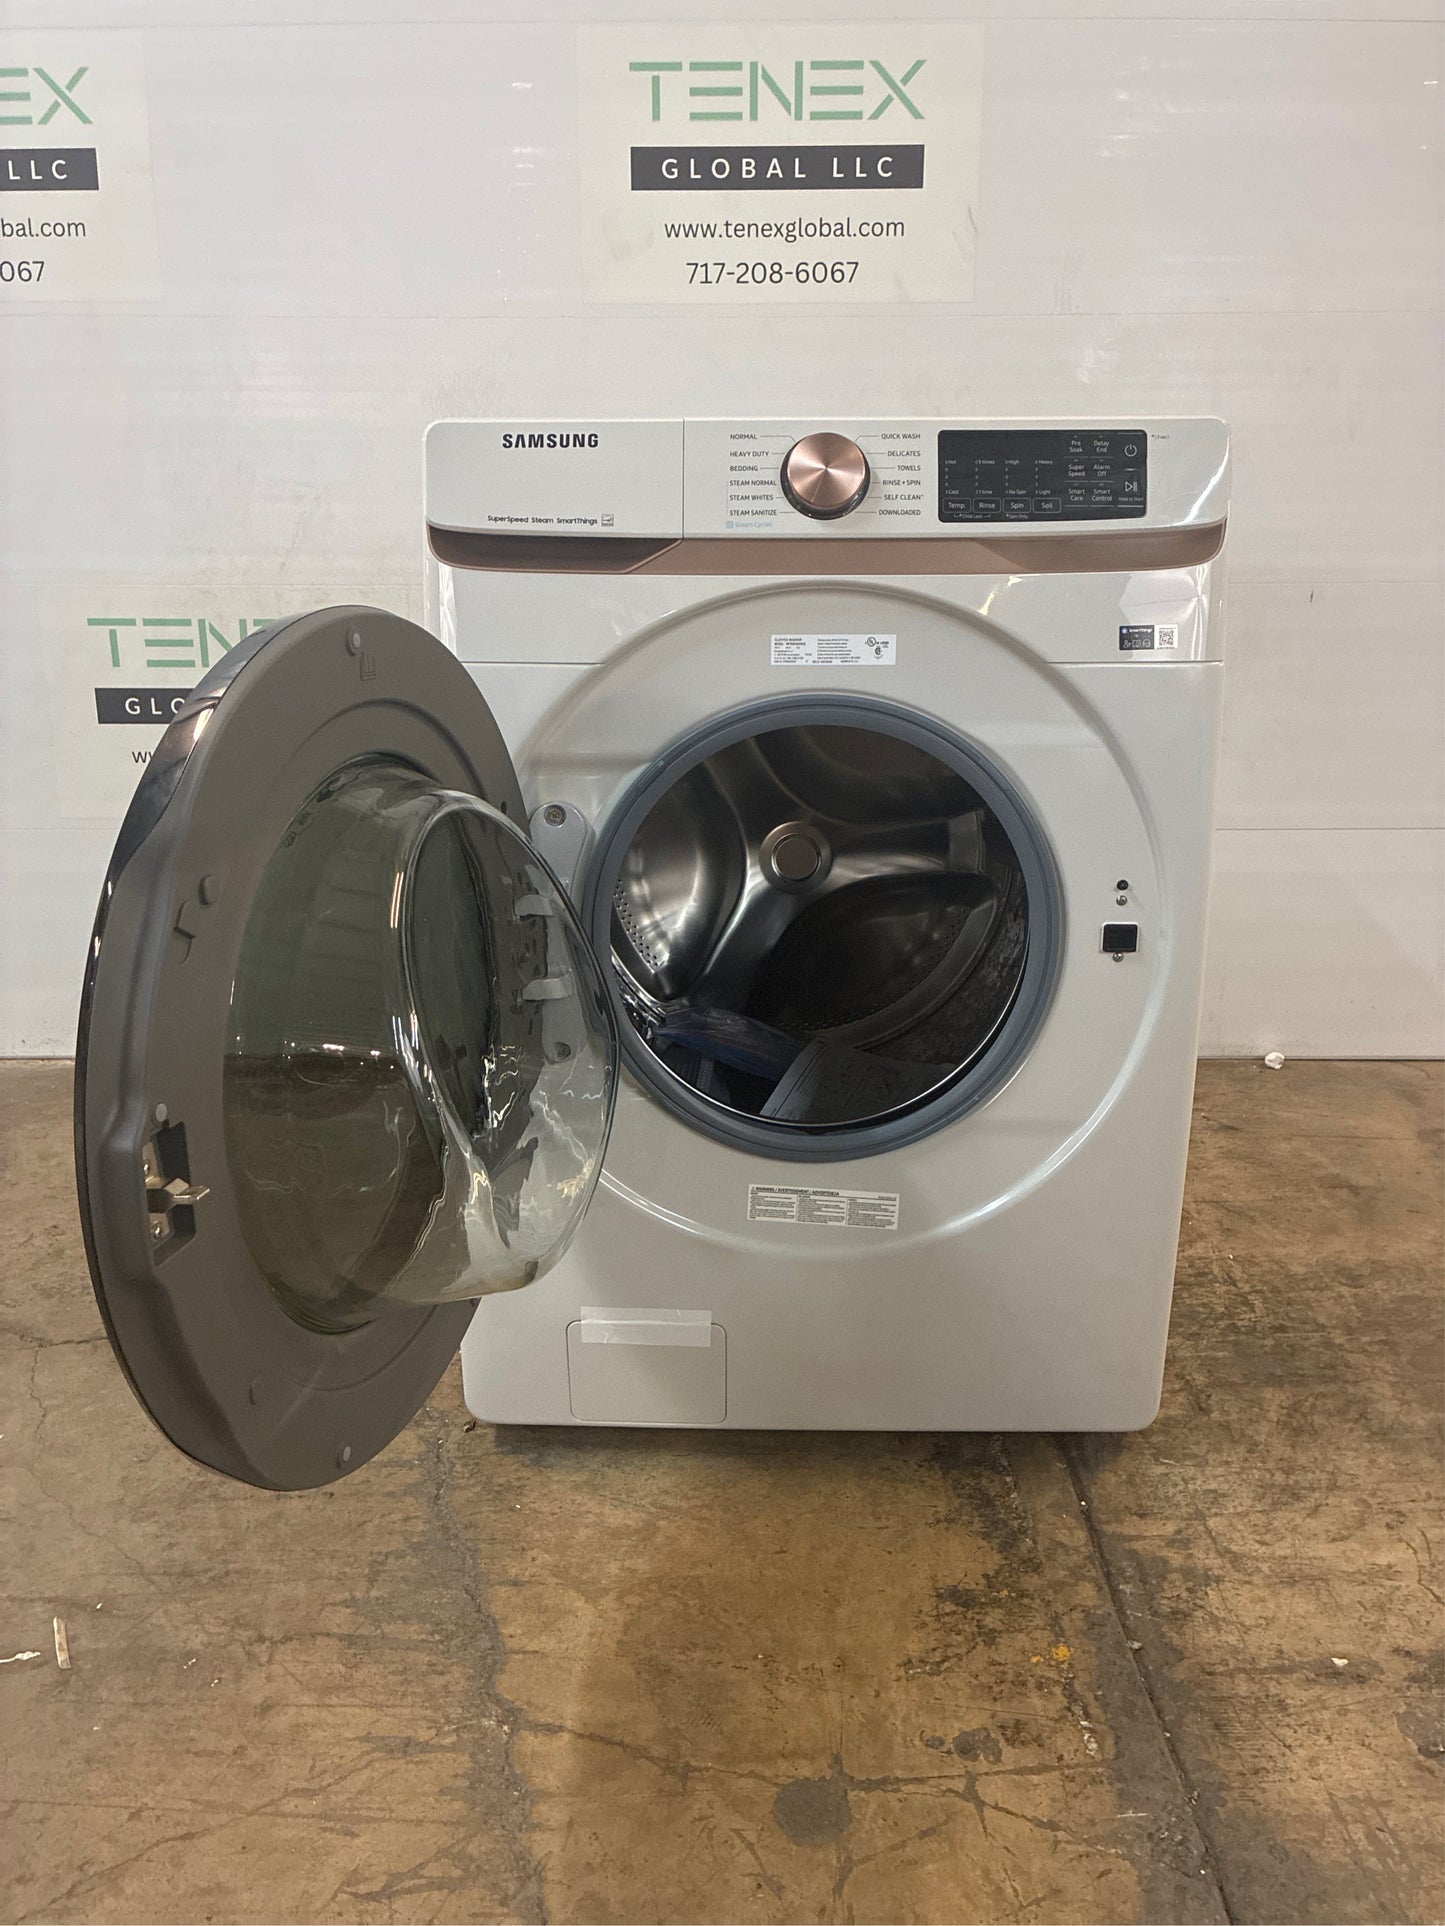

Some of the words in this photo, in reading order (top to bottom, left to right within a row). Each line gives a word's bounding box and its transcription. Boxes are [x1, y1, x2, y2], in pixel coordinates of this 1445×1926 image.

[629, 59, 927, 122] TENEX
[8, 160, 68, 180] LLC
[661, 157, 807, 180] GLOBAL
[832, 156, 894, 178] LLC
[1, 217, 86, 238] bal.com
[664, 217, 906, 243] www.tenexglobal.com
[0, 261, 45, 282] 067
[685, 261, 860, 284] 717-208-6067
[502, 433, 599, 449] SAMSUNG
[948, 501, 966, 509] Temp.
[978, 501, 996, 509] Rinse
[1010, 501, 1025, 510] Spin
[1041, 501, 1054, 509] Soil
[487, 514, 529, 524] SuperSpeed
[556, 517, 598, 526] SmartThings
[87, 618, 280, 667] TEN
[125, 697, 185, 715] GLO
